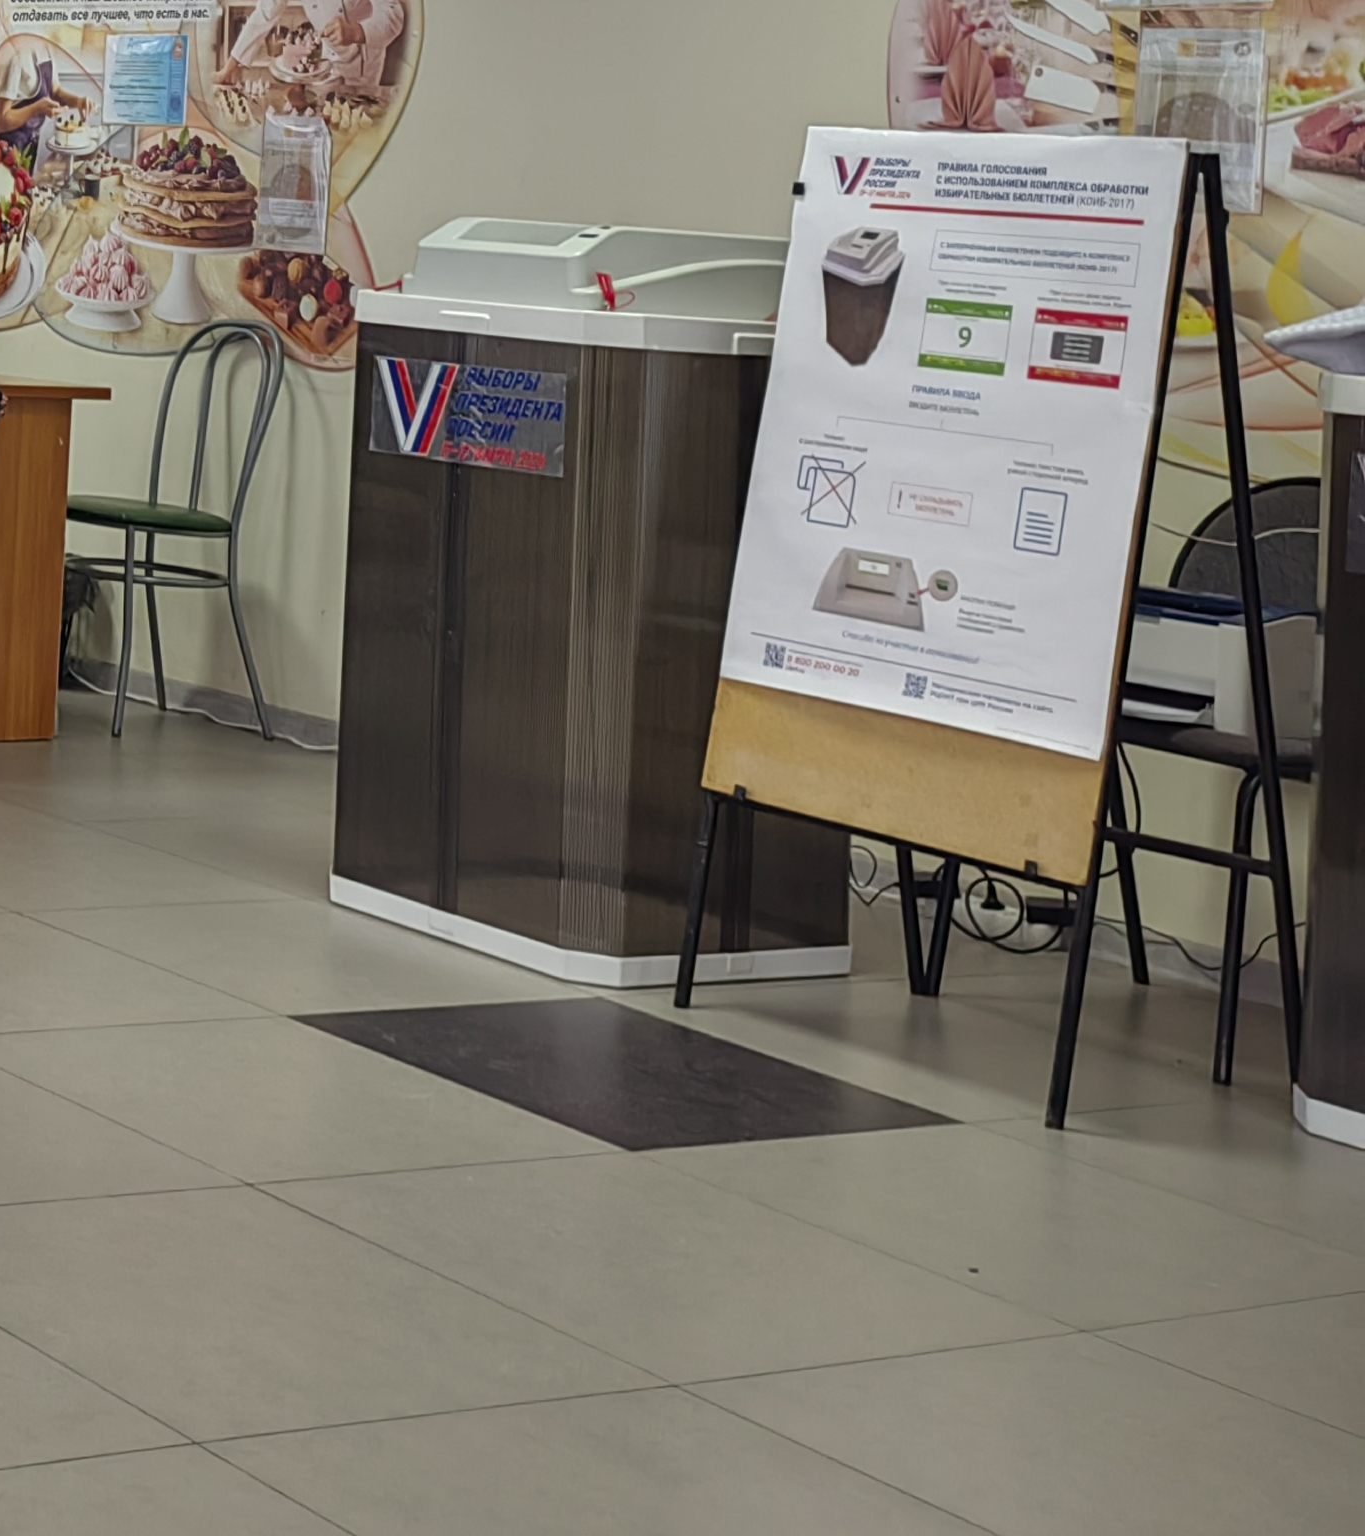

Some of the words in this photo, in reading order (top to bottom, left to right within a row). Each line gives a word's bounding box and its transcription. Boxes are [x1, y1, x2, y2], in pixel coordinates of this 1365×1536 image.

[12, 9, 69, 22] отдавать
[70, 10, 89, 20] все
[90, 10, 131, 24] лучшее,
[133, 10, 154, 19] что
[155, 9, 181, 19] есть
[183, 8, 190, 18] в
[190, 8, 210, 19] нас.
[937, 162, 979, 173] ПРАВИЛА
[980, 164, 1047, 176] ГОЛОСОВАНИЯ
[936, 175, 942, 185] С
[944, 175, 1029, 189] ИСПОЛЬЗОВАНИЕМ
[1029, 180, 1088, 192] КОМПЛЕКСА
[1090, 183, 1149, 195] ОБРАБОТКИ
[934, 188, 1010, 201] ИЗБИРАТЕЛЬНЫХ
[1012, 192, 1075, 205] БЮЛЛЕТЕНЕЙ
[1076, 195, 1135, 210] (КОИБ-2017)
[958, 326, 972, 348] 9
[465, 366, 541, 392] ВЫБОРЫ
[455, 393, 564, 422] ПРЕЗИДЕНТА
